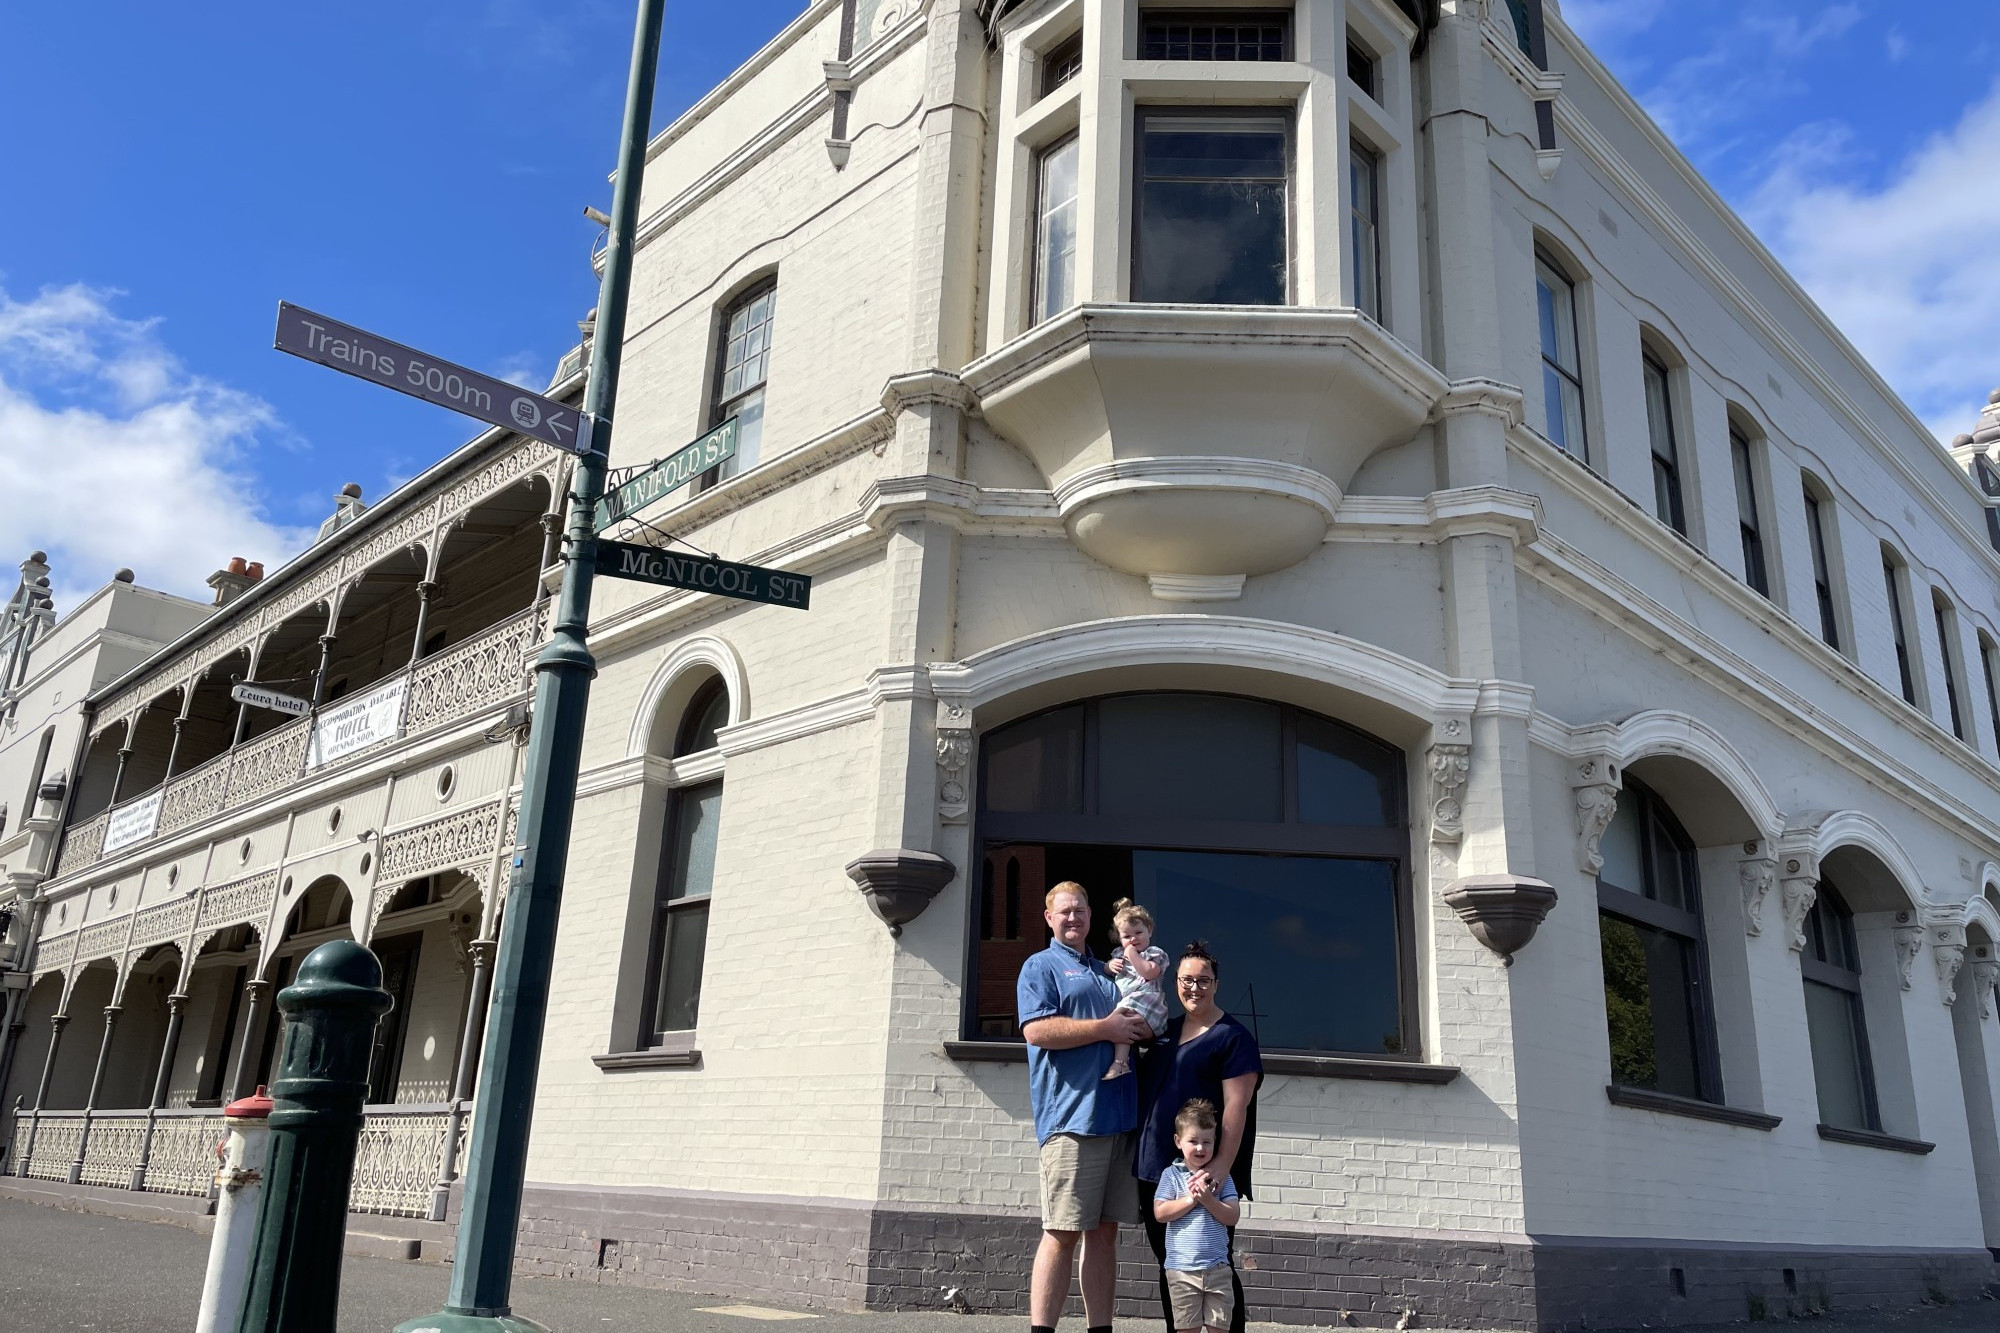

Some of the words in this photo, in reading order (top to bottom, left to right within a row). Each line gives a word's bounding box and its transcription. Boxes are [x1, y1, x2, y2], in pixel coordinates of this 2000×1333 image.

[301, 320, 395, 377] Trains
[406, 359, 492, 412] 500m
[605, 447, 701, 523] MANIFOLD
[704, 425, 732, 464] ST
[619, 548, 759, 596] McNICOL
[768, 575, 804, 603] ST
[319, 703, 366, 729] CCOMMODATION
[336, 712, 371, 743] HOTEL
[327, 738, 355, 756] OPENING
[356, 729, 376, 745] SOON
